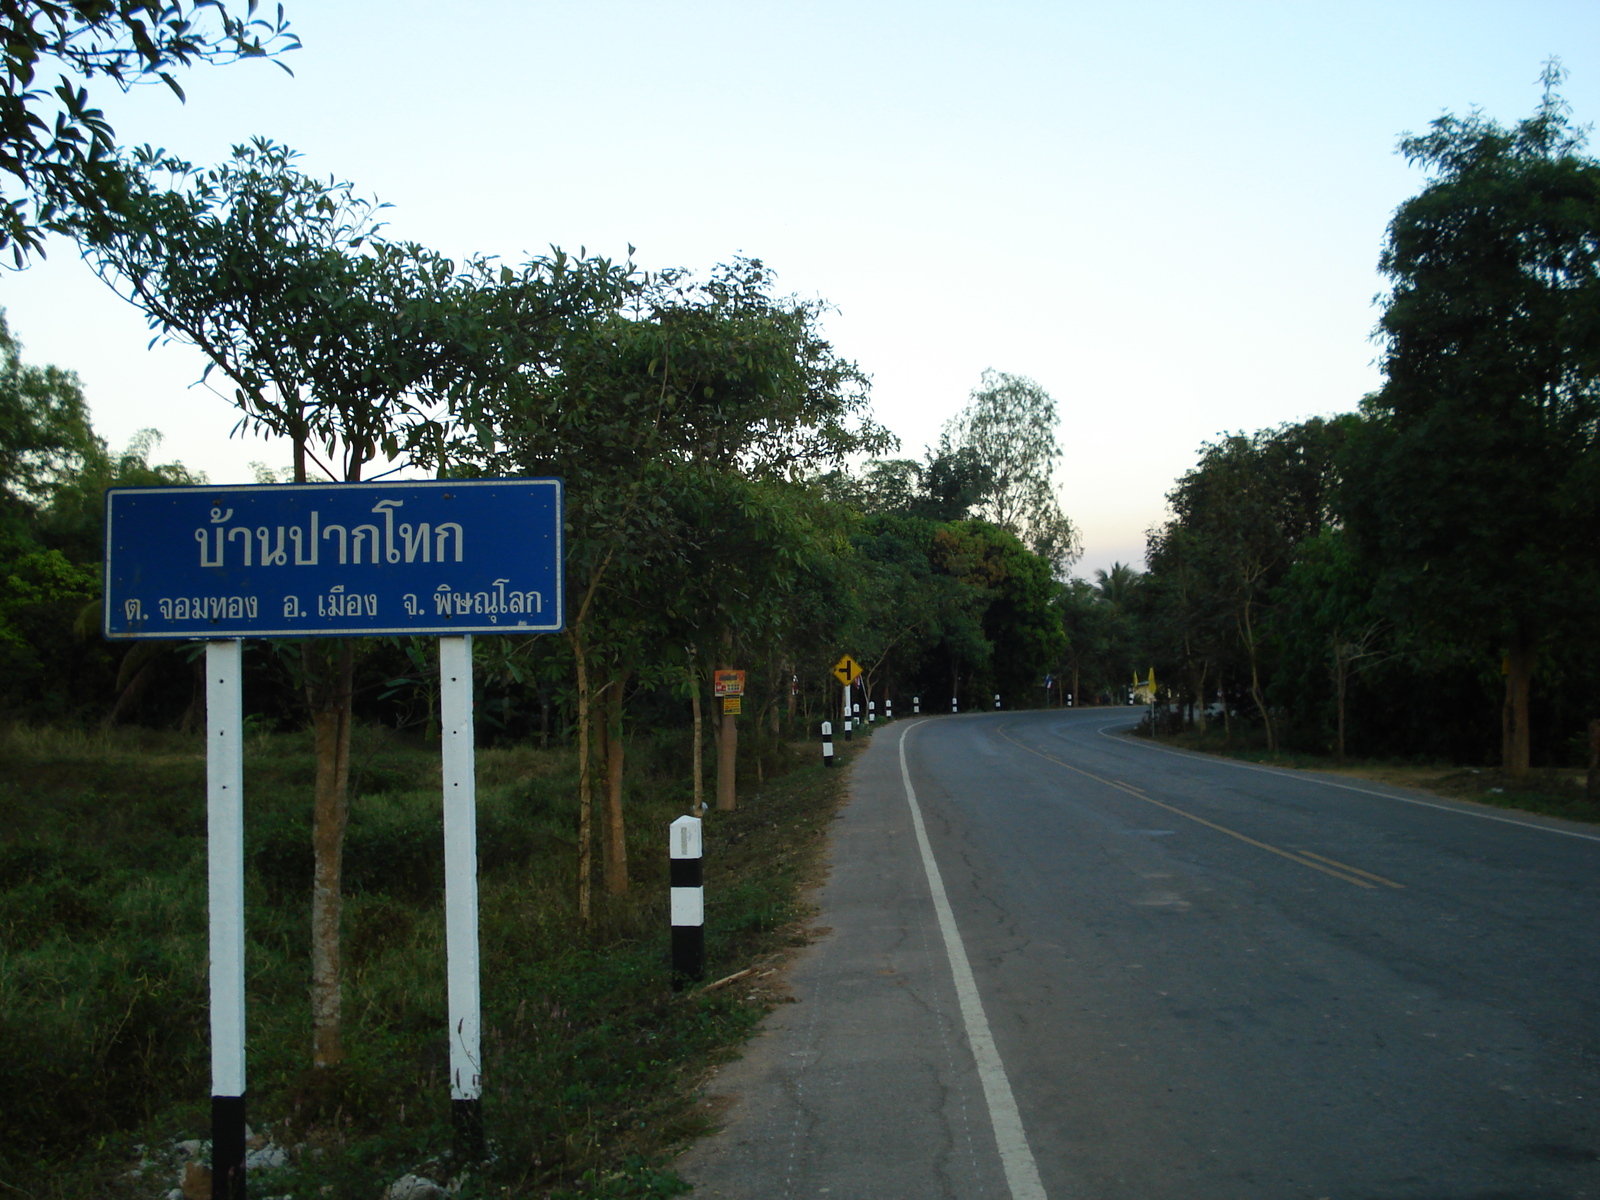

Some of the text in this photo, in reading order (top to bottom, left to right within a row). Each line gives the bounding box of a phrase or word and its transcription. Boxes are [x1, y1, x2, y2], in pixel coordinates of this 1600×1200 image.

[194, 499, 463, 567] บ้านปากโทก
[124, 578, 542, 624] ต. จอมทอง อ. เมือง จ. พิษณุโลก
